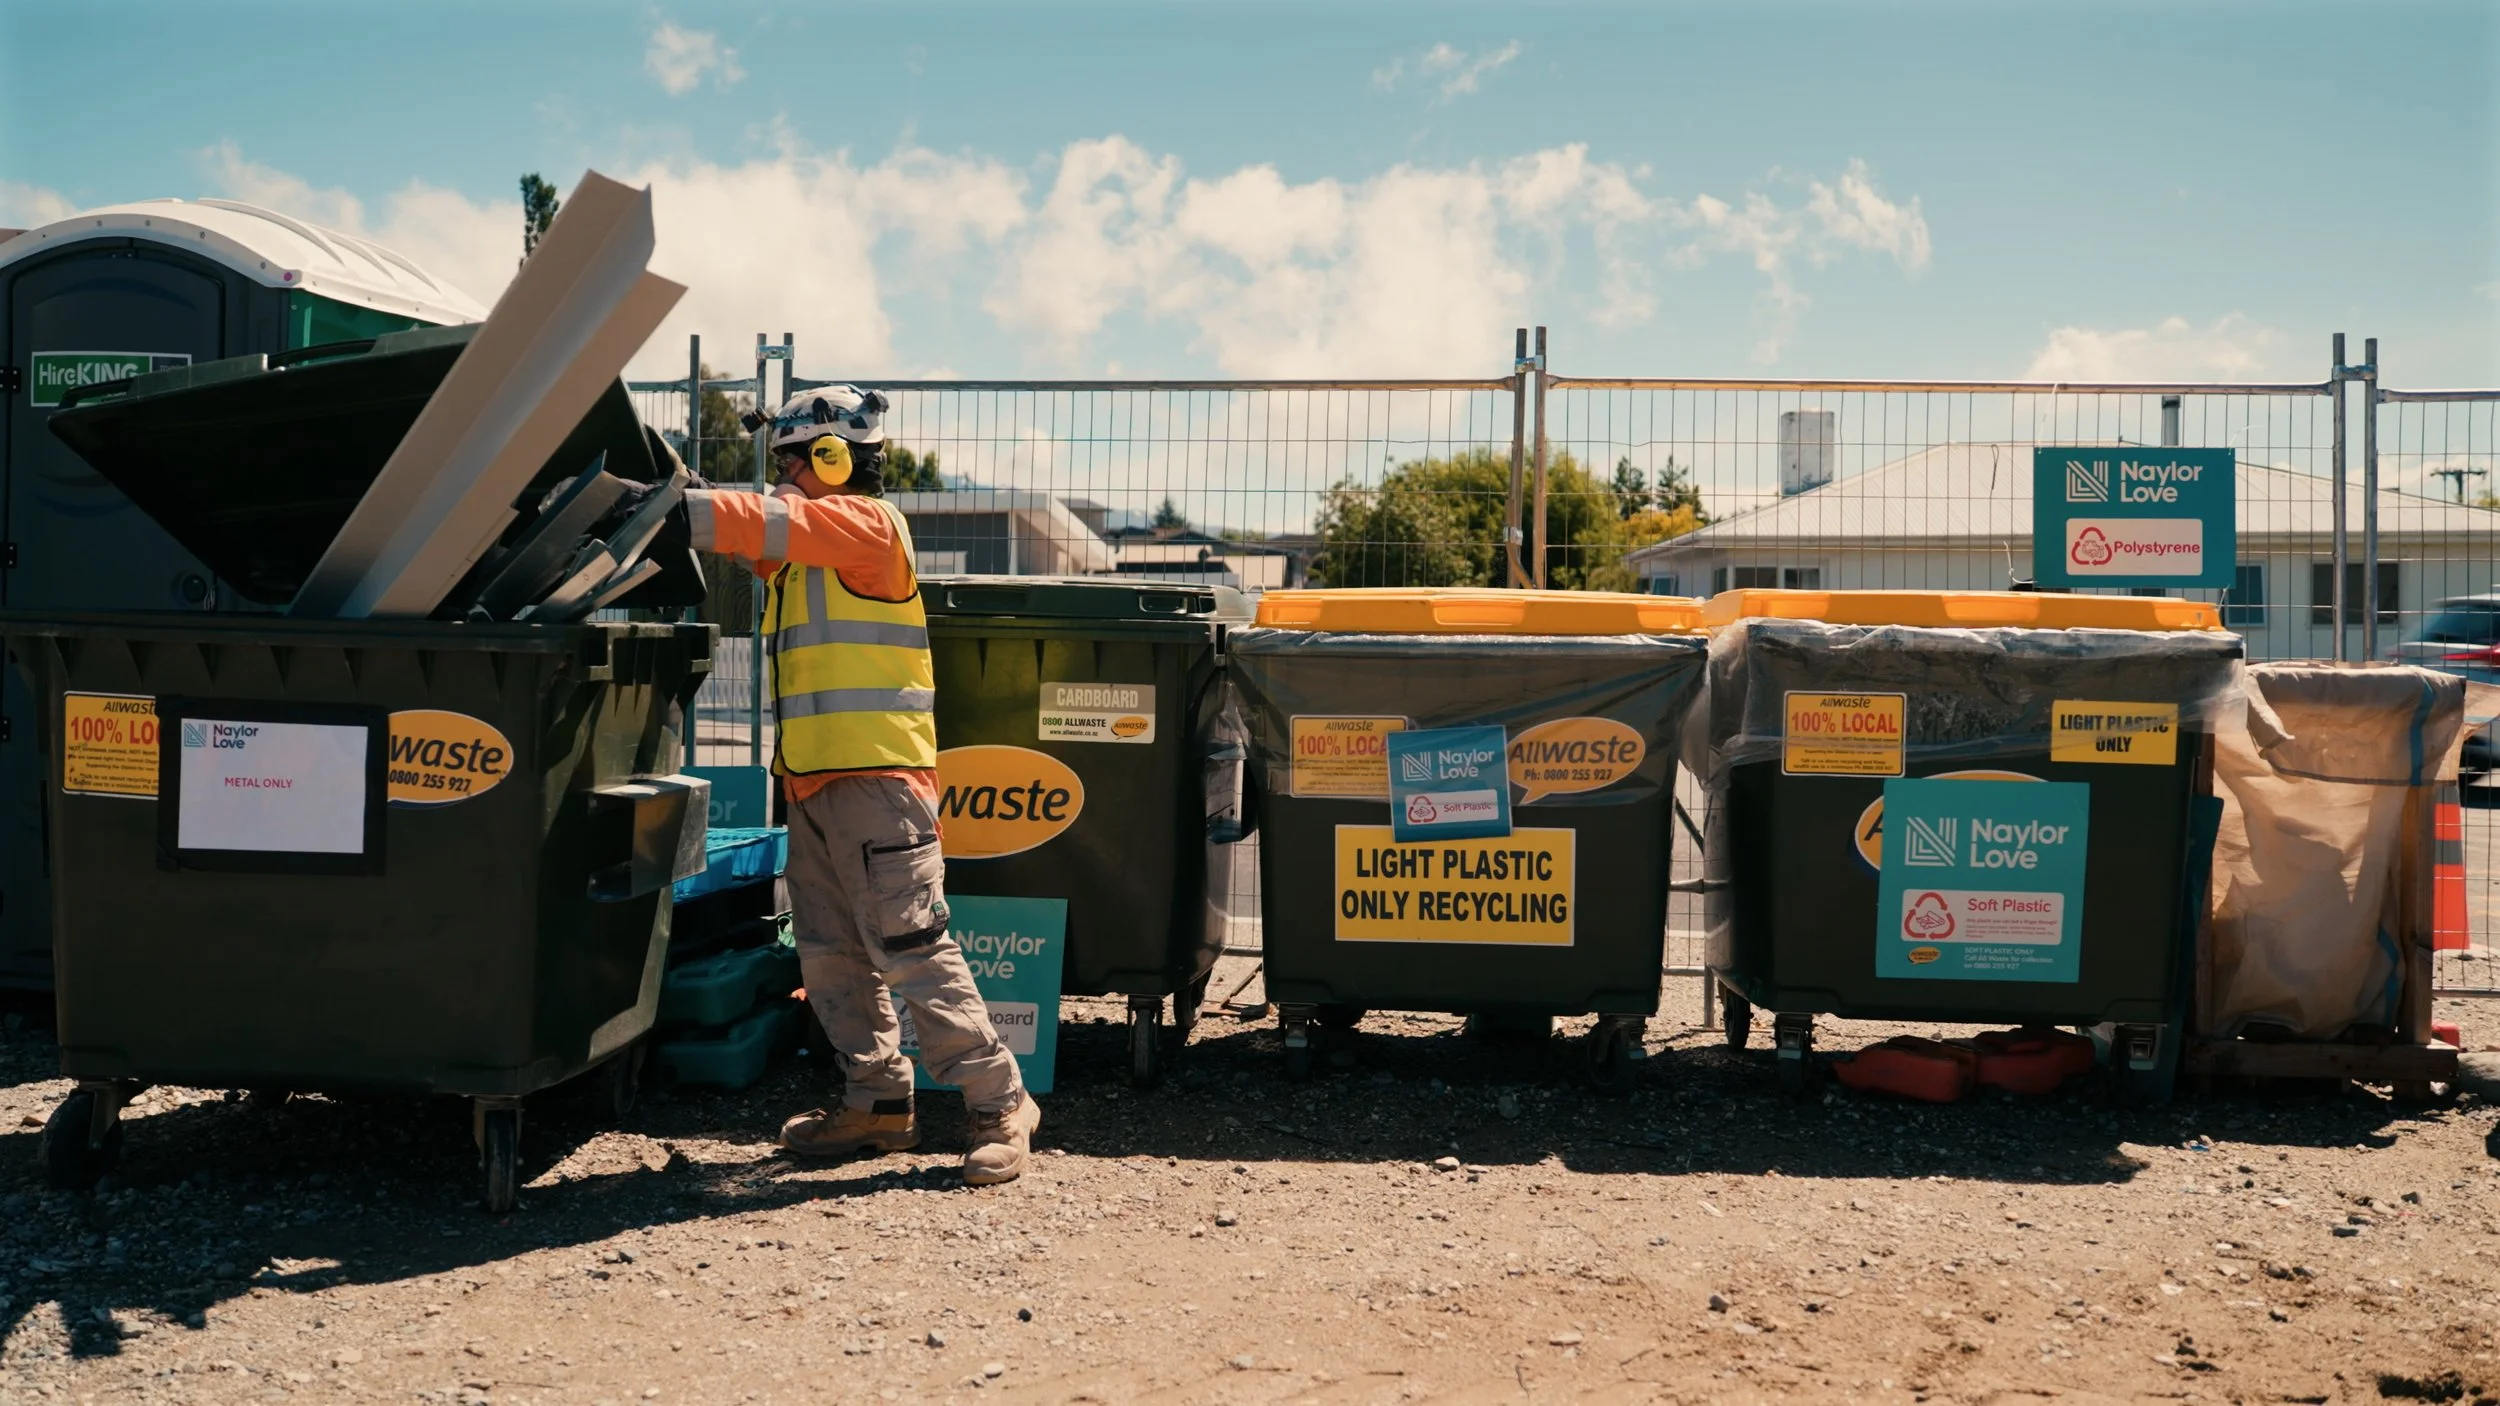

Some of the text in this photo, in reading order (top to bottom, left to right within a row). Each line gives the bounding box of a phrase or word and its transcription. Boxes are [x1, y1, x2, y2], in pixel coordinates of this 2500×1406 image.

[39, 362, 139, 386] HireKING
[2120, 460, 2203, 486] Naylor
[2120, 481, 2178, 503] Love
[2113, 540, 2200, 556] Polystyrene
[103, 701, 156, 715] Allwast
[1056, 687, 1139, 709] CARDBOARD
[1819, 697, 1871, 708] Allwaste
[71, 716, 123, 744] 100%
[213, 724, 259, 739] Naylor
[1042, 717, 1106, 728] 0800 ALLWASTE
[1324, 720, 1374, 731] Allwaste
[1792, 711, 1898, 734] 100% LOCAL
[2060, 714, 2104, 731] LIGHT
[213, 736, 246, 749] Love
[1298, 735, 1387, 756] 100% LOCA
[1508, 735, 1638, 765] Allwaste
[2096, 736, 2132, 752] ONLY
[390, 735, 504, 775] waste
[1438, 748, 1495, 765] Naylor
[224, 777, 293, 789] METAL ONLY
[389, 769, 473, 792] 0800 255 927
[1439, 764, 1479, 781] Love
[1524, 768, 1613, 781] Ph: 0800 255 927
[938, 779, 1070, 822] waste
[1443, 801, 1492, 813] Soft Plastic
[1970, 817, 2069, 849] Naylor
[1356, 848, 1553, 881] LIGHT PLASTIC
[1969, 842, 2038, 869] Love
[1341, 889, 1567, 923] ONLY RECYCLING
[1967, 898, 2052, 912] Soft Plastic
[955, 930, 1046, 959] Naylor
[968, 959, 1016, 980] ove
